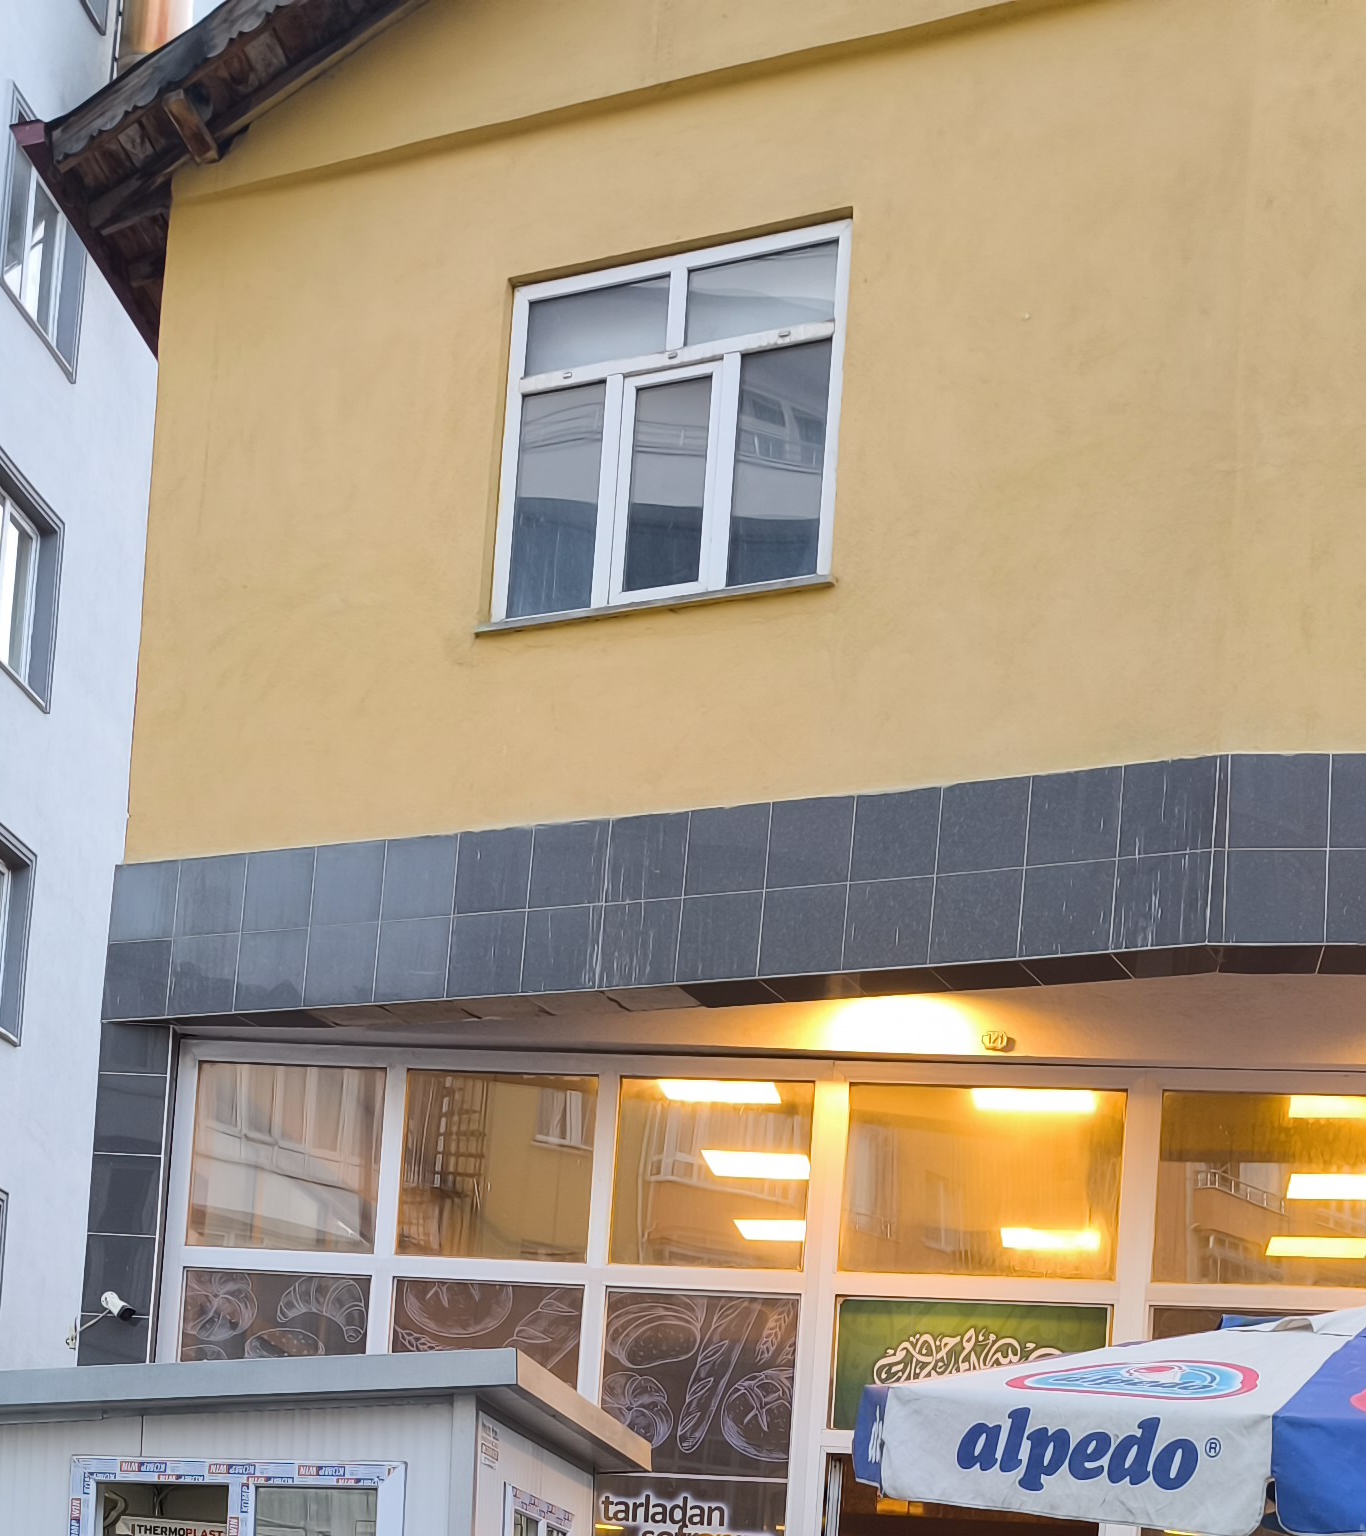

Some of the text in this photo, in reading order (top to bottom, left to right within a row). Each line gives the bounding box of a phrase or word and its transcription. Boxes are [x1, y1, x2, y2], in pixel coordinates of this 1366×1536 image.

[298, 1465, 345, 1477] KOMP WIN
[601, 1494, 725, 1527] tarladan
